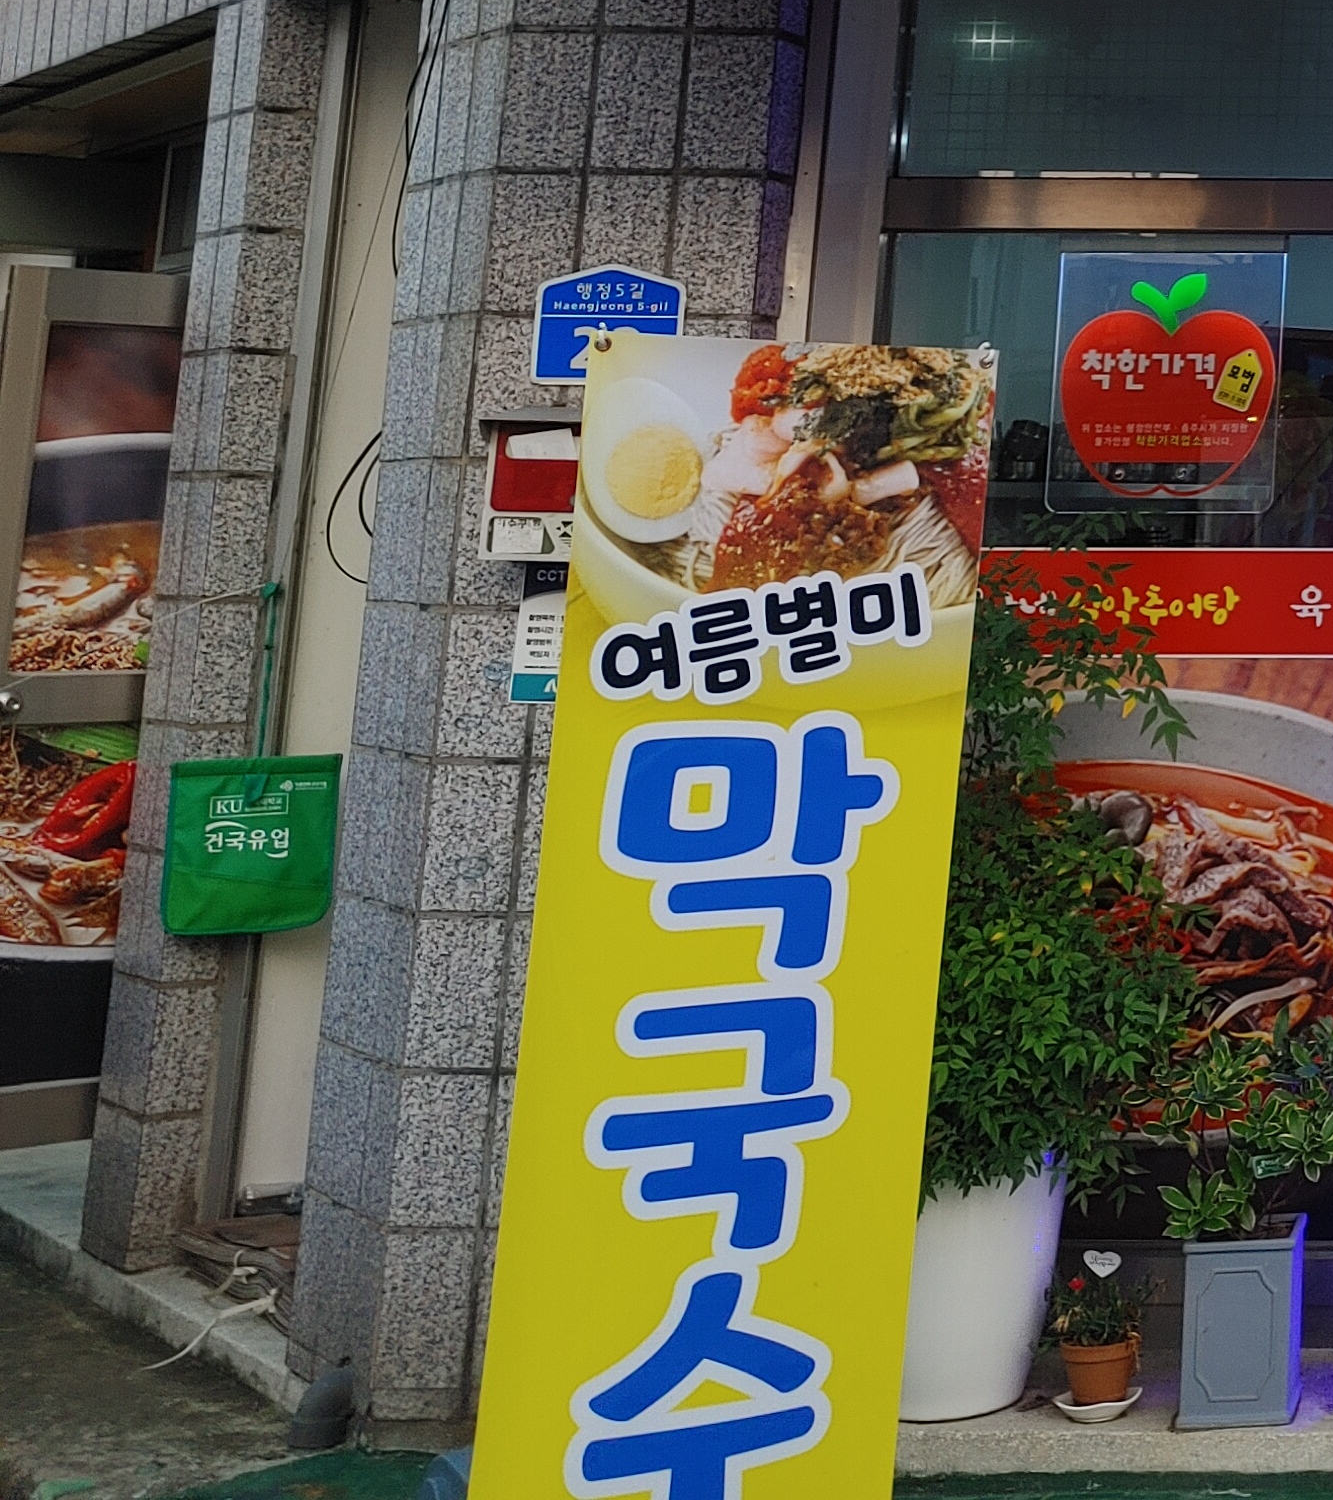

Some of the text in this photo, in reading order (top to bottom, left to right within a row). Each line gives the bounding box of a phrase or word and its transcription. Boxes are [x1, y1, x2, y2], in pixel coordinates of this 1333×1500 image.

[576, 282, 645, 300] 행정5길
[553, 301, 634, 313] Haengjeong
[1081, 348, 1217, 392] 착한가격
[1227, 364, 1256, 394] 모범
[600, 572, 924, 696] 여름별미
[215, 800, 244, 815] KU
[204, 827, 290, 854] 건국유업
[582, 725, 885, 1500] 막국수
